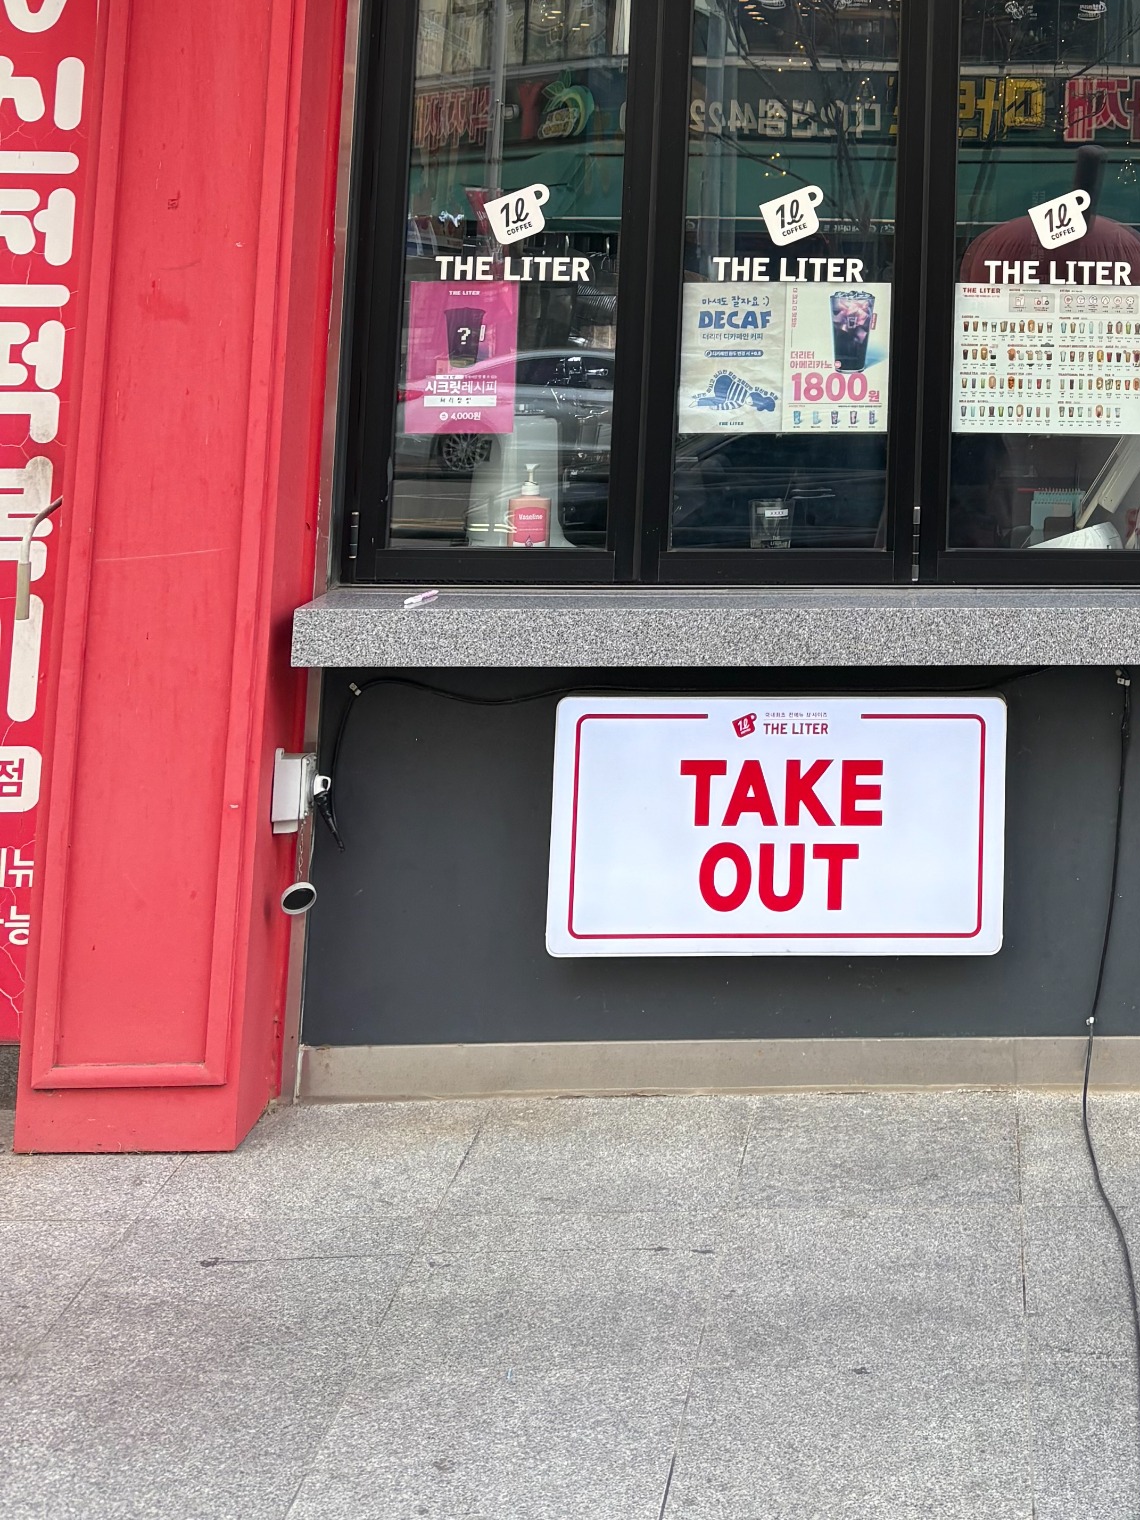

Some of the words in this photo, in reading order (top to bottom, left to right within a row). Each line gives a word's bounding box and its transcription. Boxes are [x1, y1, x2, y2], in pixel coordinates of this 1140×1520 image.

[507, 221, 533, 235] COFFEE
[782, 223, 807, 236] COFFEE
[1051, 227, 1076, 241] COFFEE
[435, 256, 493, 280] THE
[503, 256, 590, 281] LITER
[713, 257, 769, 282] THE
[780, 257, 864, 282] LITER
[984, 260, 1039, 284] THE
[1049, 261, 1131, 285] LITER
[698, 310, 771, 329] DECAF
[791, 351, 814, 359] 더리터
[425, 380, 497, 394] 시크릿레시피
[450, 412, 481, 420] 4,000원
[763, 723, 787, 735] THE
[792, 723, 829, 735] LITER
[680, 759, 884, 827] TAKE
[698, 841, 860, 912] OUT
